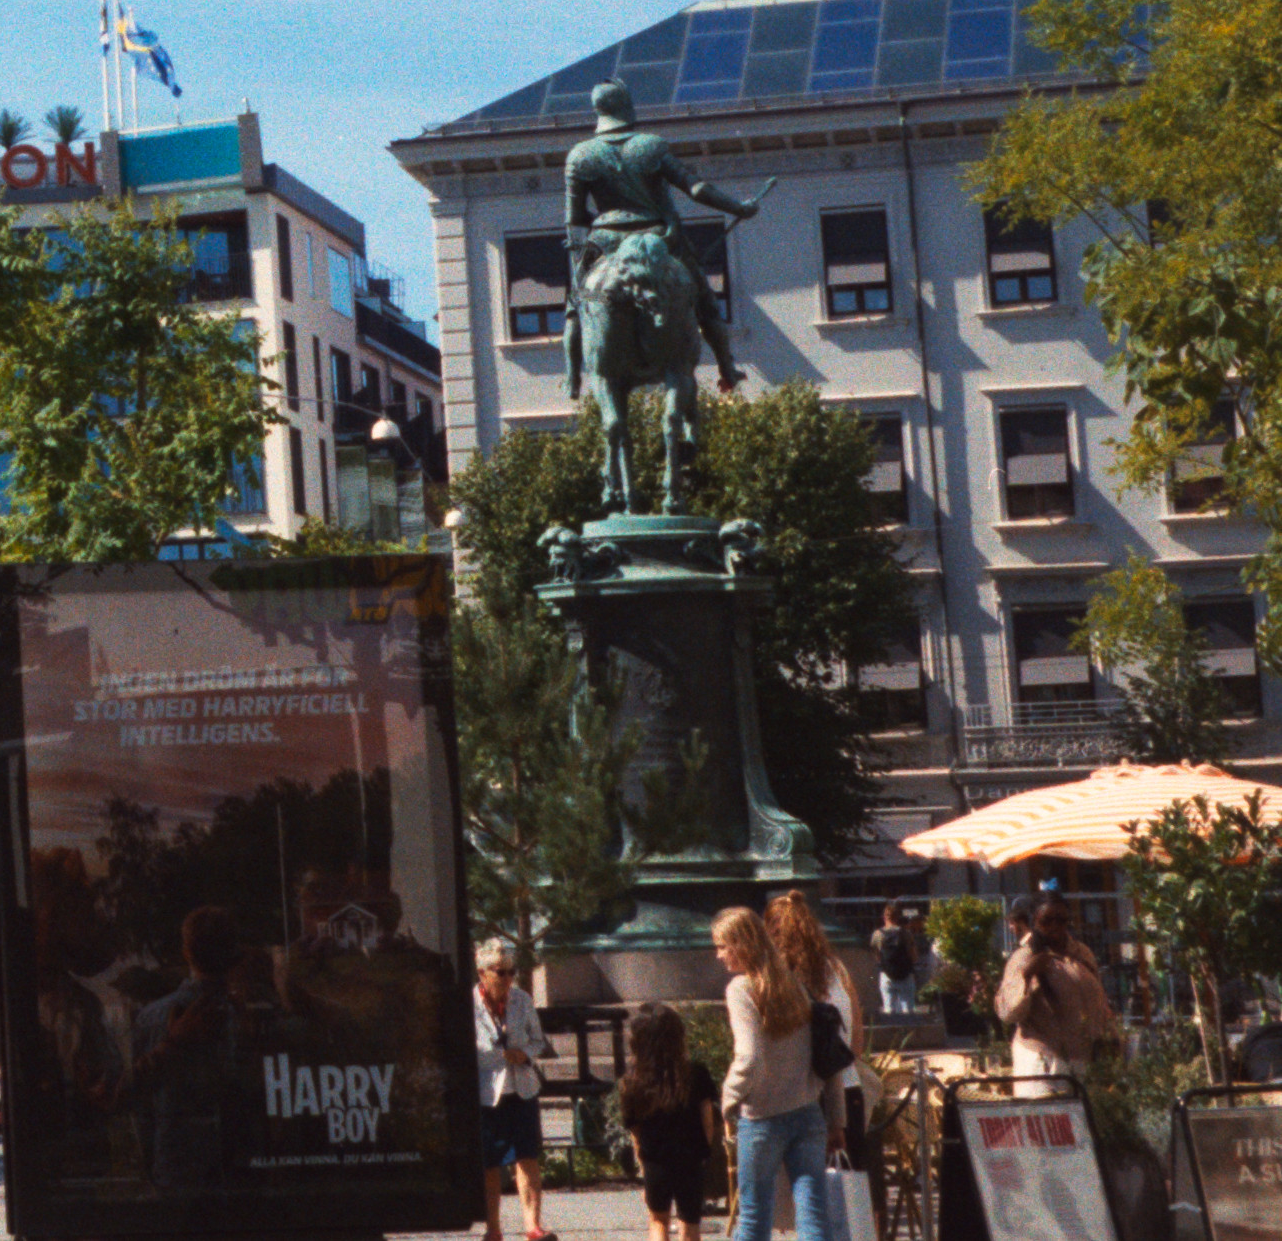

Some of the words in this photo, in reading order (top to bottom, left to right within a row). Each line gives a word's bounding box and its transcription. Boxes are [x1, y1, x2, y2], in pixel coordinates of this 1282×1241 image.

[98, 672, 179, 696] INGEN
[186, 665, 257, 690] DRÖM
[262, 663, 296, 688] ÄR
[302, 661, 351, 686] FÖR
[73, 700, 137, 722] STOR
[143, 698, 197, 720] MED
[202, 692, 371, 718] HARRYFICIELL
[119, 722, 282, 747] INTELLIGENS.
[262, 1052, 396, 1119] HARRY
[327, 1107, 380, 1144] BOY
[249, 1156, 278, 1169] ALLA
[343, 1153, 359, 1166] DU
